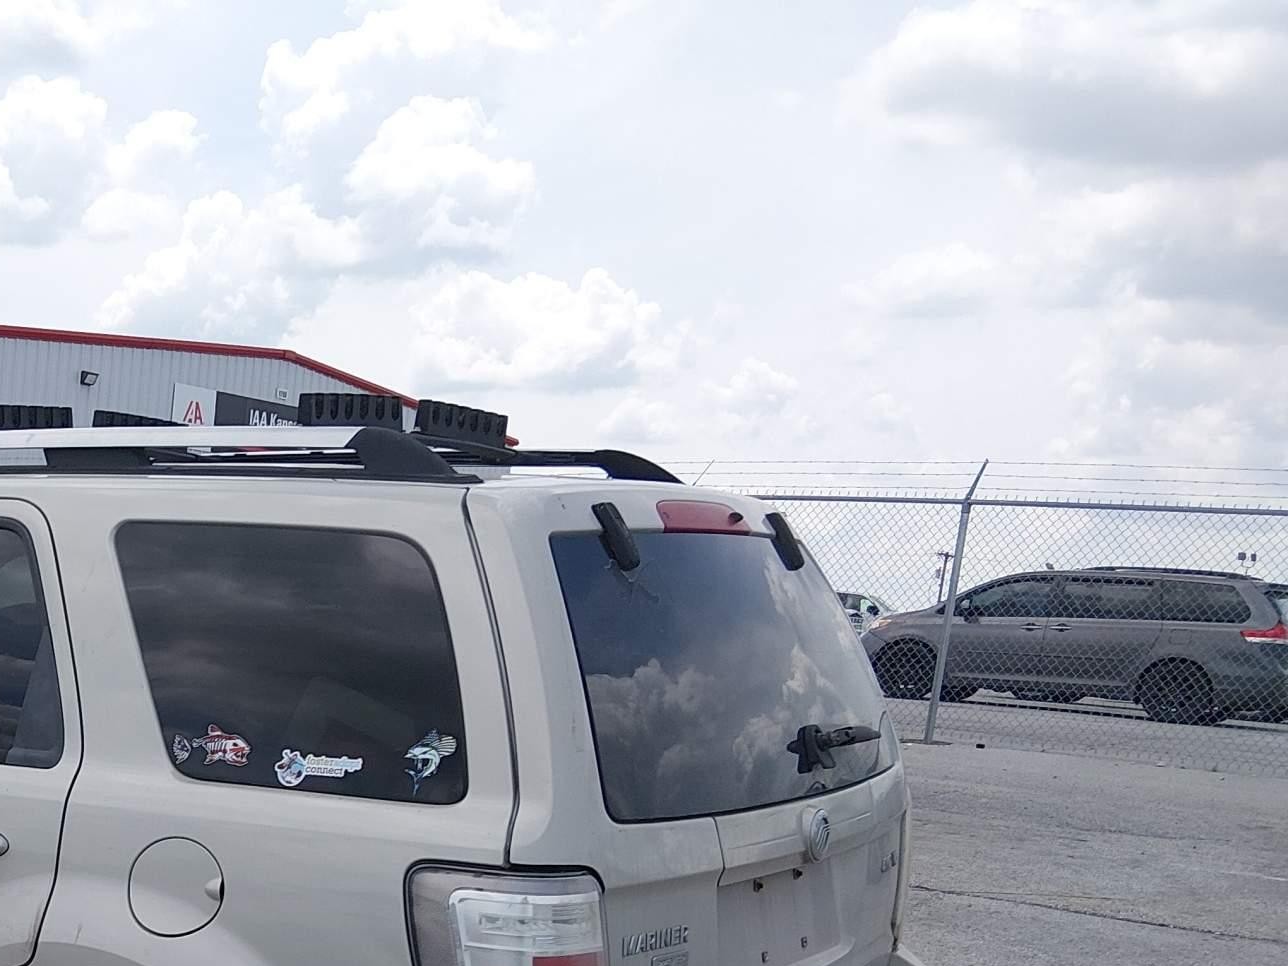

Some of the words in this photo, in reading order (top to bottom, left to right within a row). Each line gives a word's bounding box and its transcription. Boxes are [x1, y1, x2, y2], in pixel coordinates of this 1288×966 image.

[249, 409, 267, 427] IAA
[305, 765, 343, 775] connect
[622, 924, 689, 958] MARINER
